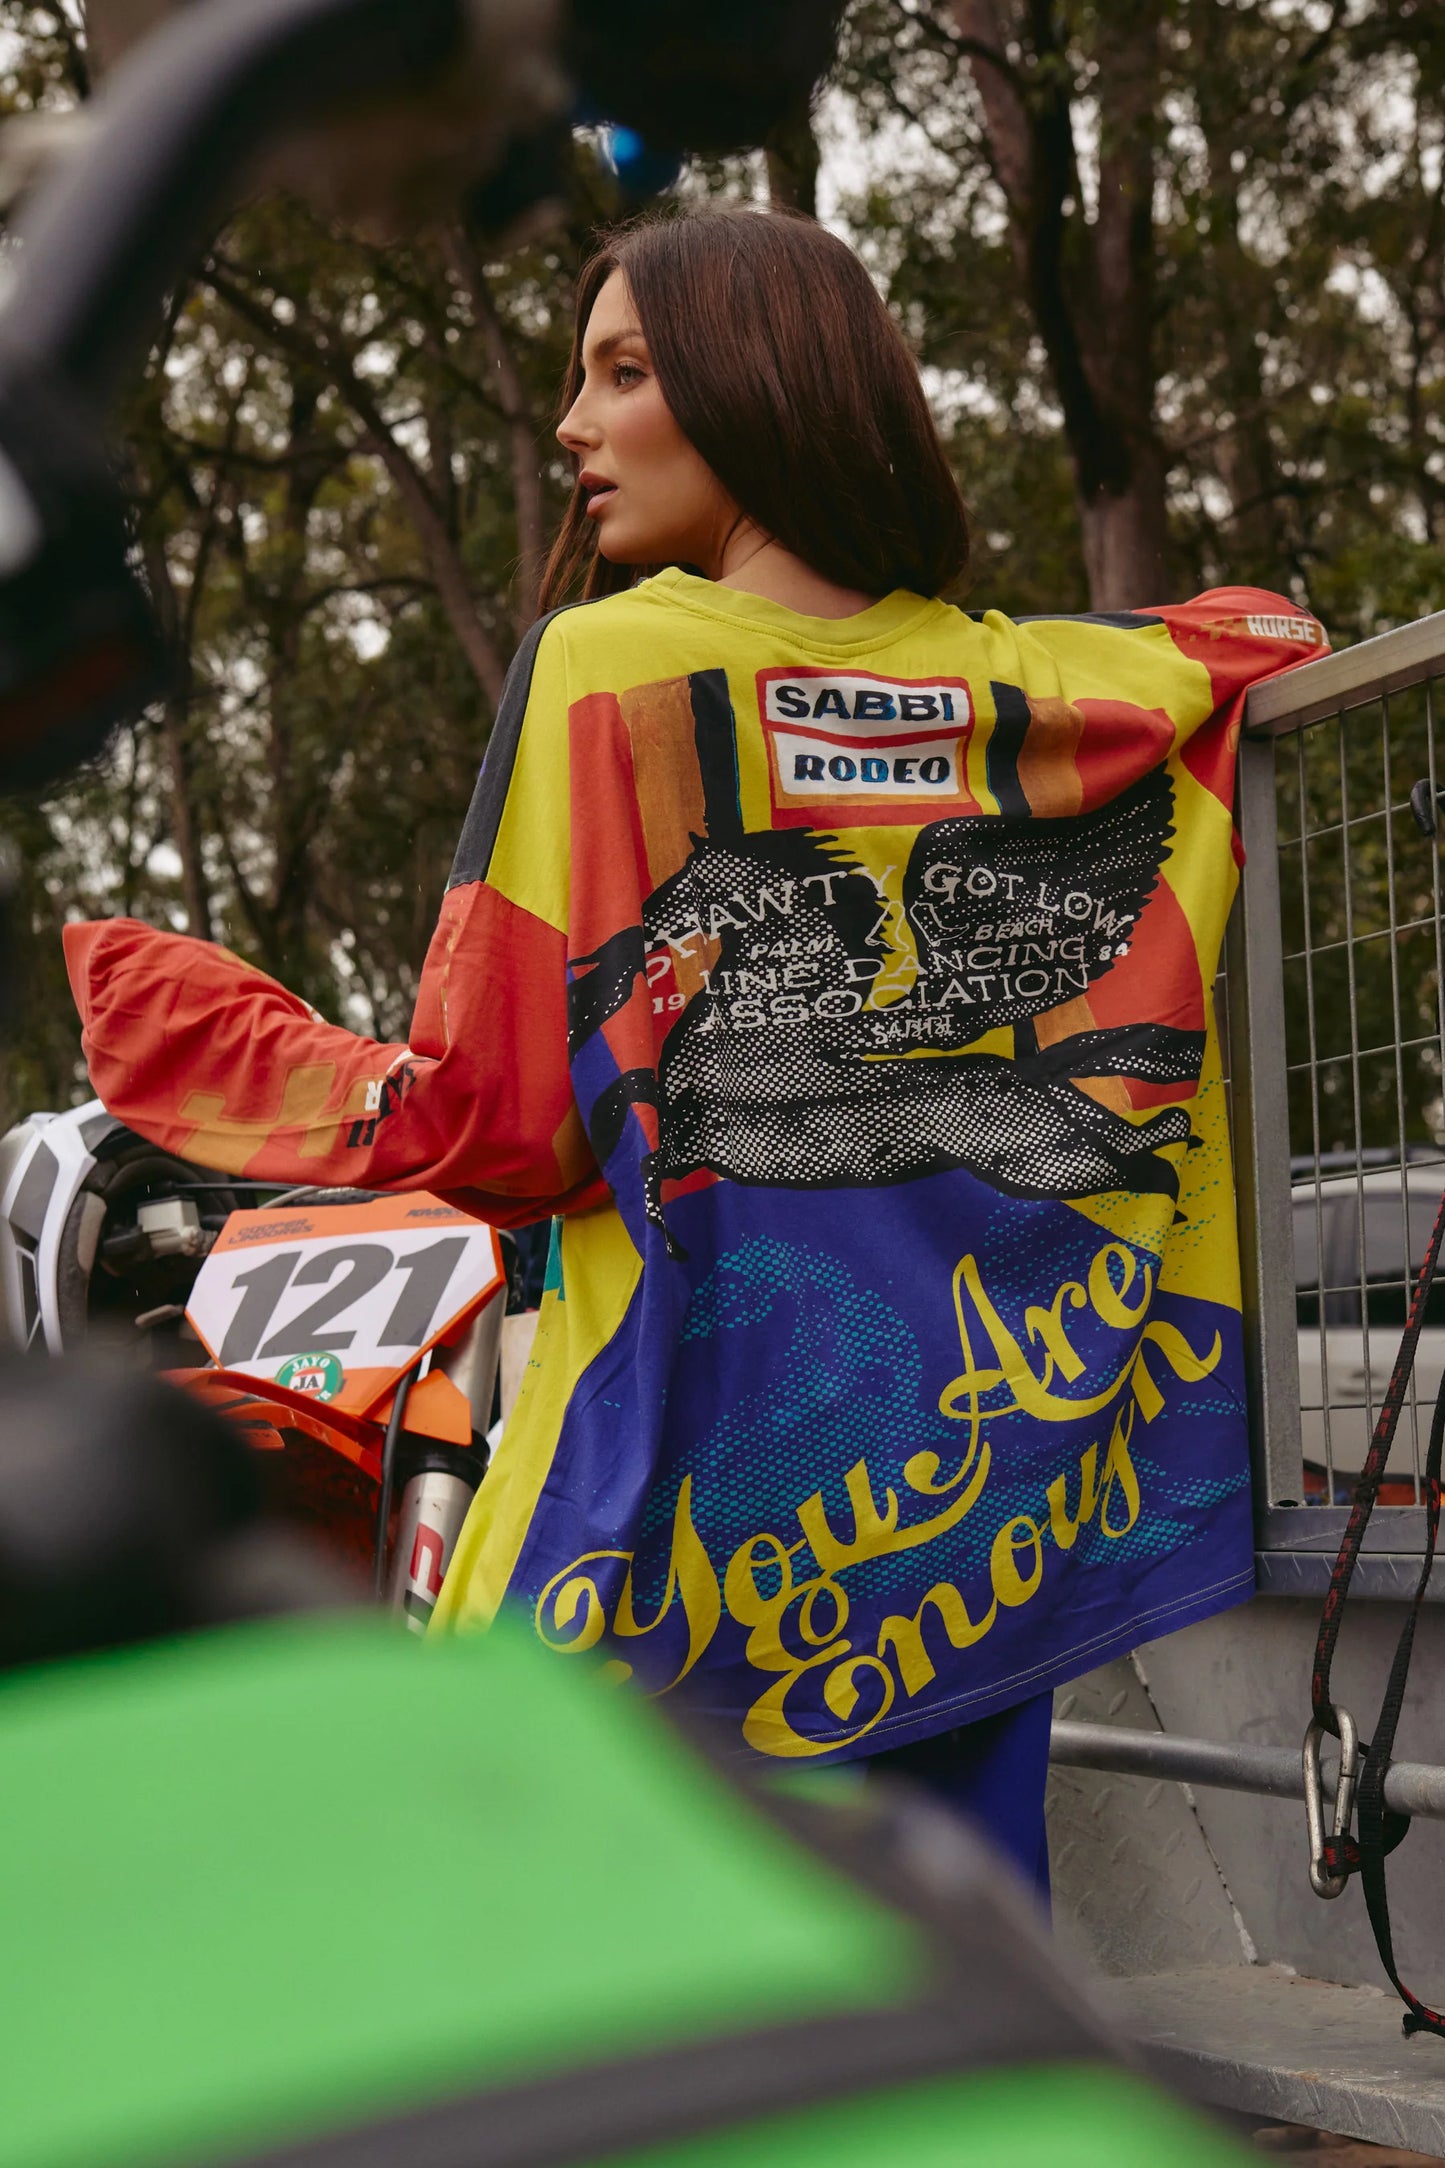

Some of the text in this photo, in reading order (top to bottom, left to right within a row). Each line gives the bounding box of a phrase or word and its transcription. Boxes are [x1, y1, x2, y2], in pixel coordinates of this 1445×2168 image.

[1246, 615, 1317, 643] HORSE
[775, 685, 955, 721] SABBI
[794, 754, 950, 784] RODEO
[924, 864, 1024, 904] GOT
[1037, 882, 1135, 937] LOW
[699, 936, 1085, 996] LINE DANCING
[750, 918, 1054, 961] PALM BEACH
[694, 964, 1091, 1033] ASSOCIATION
[212, 1236, 470, 1369] 121
[535, 1441, 992, 1702] You
[904, 1242, 1153, 1495] Are
